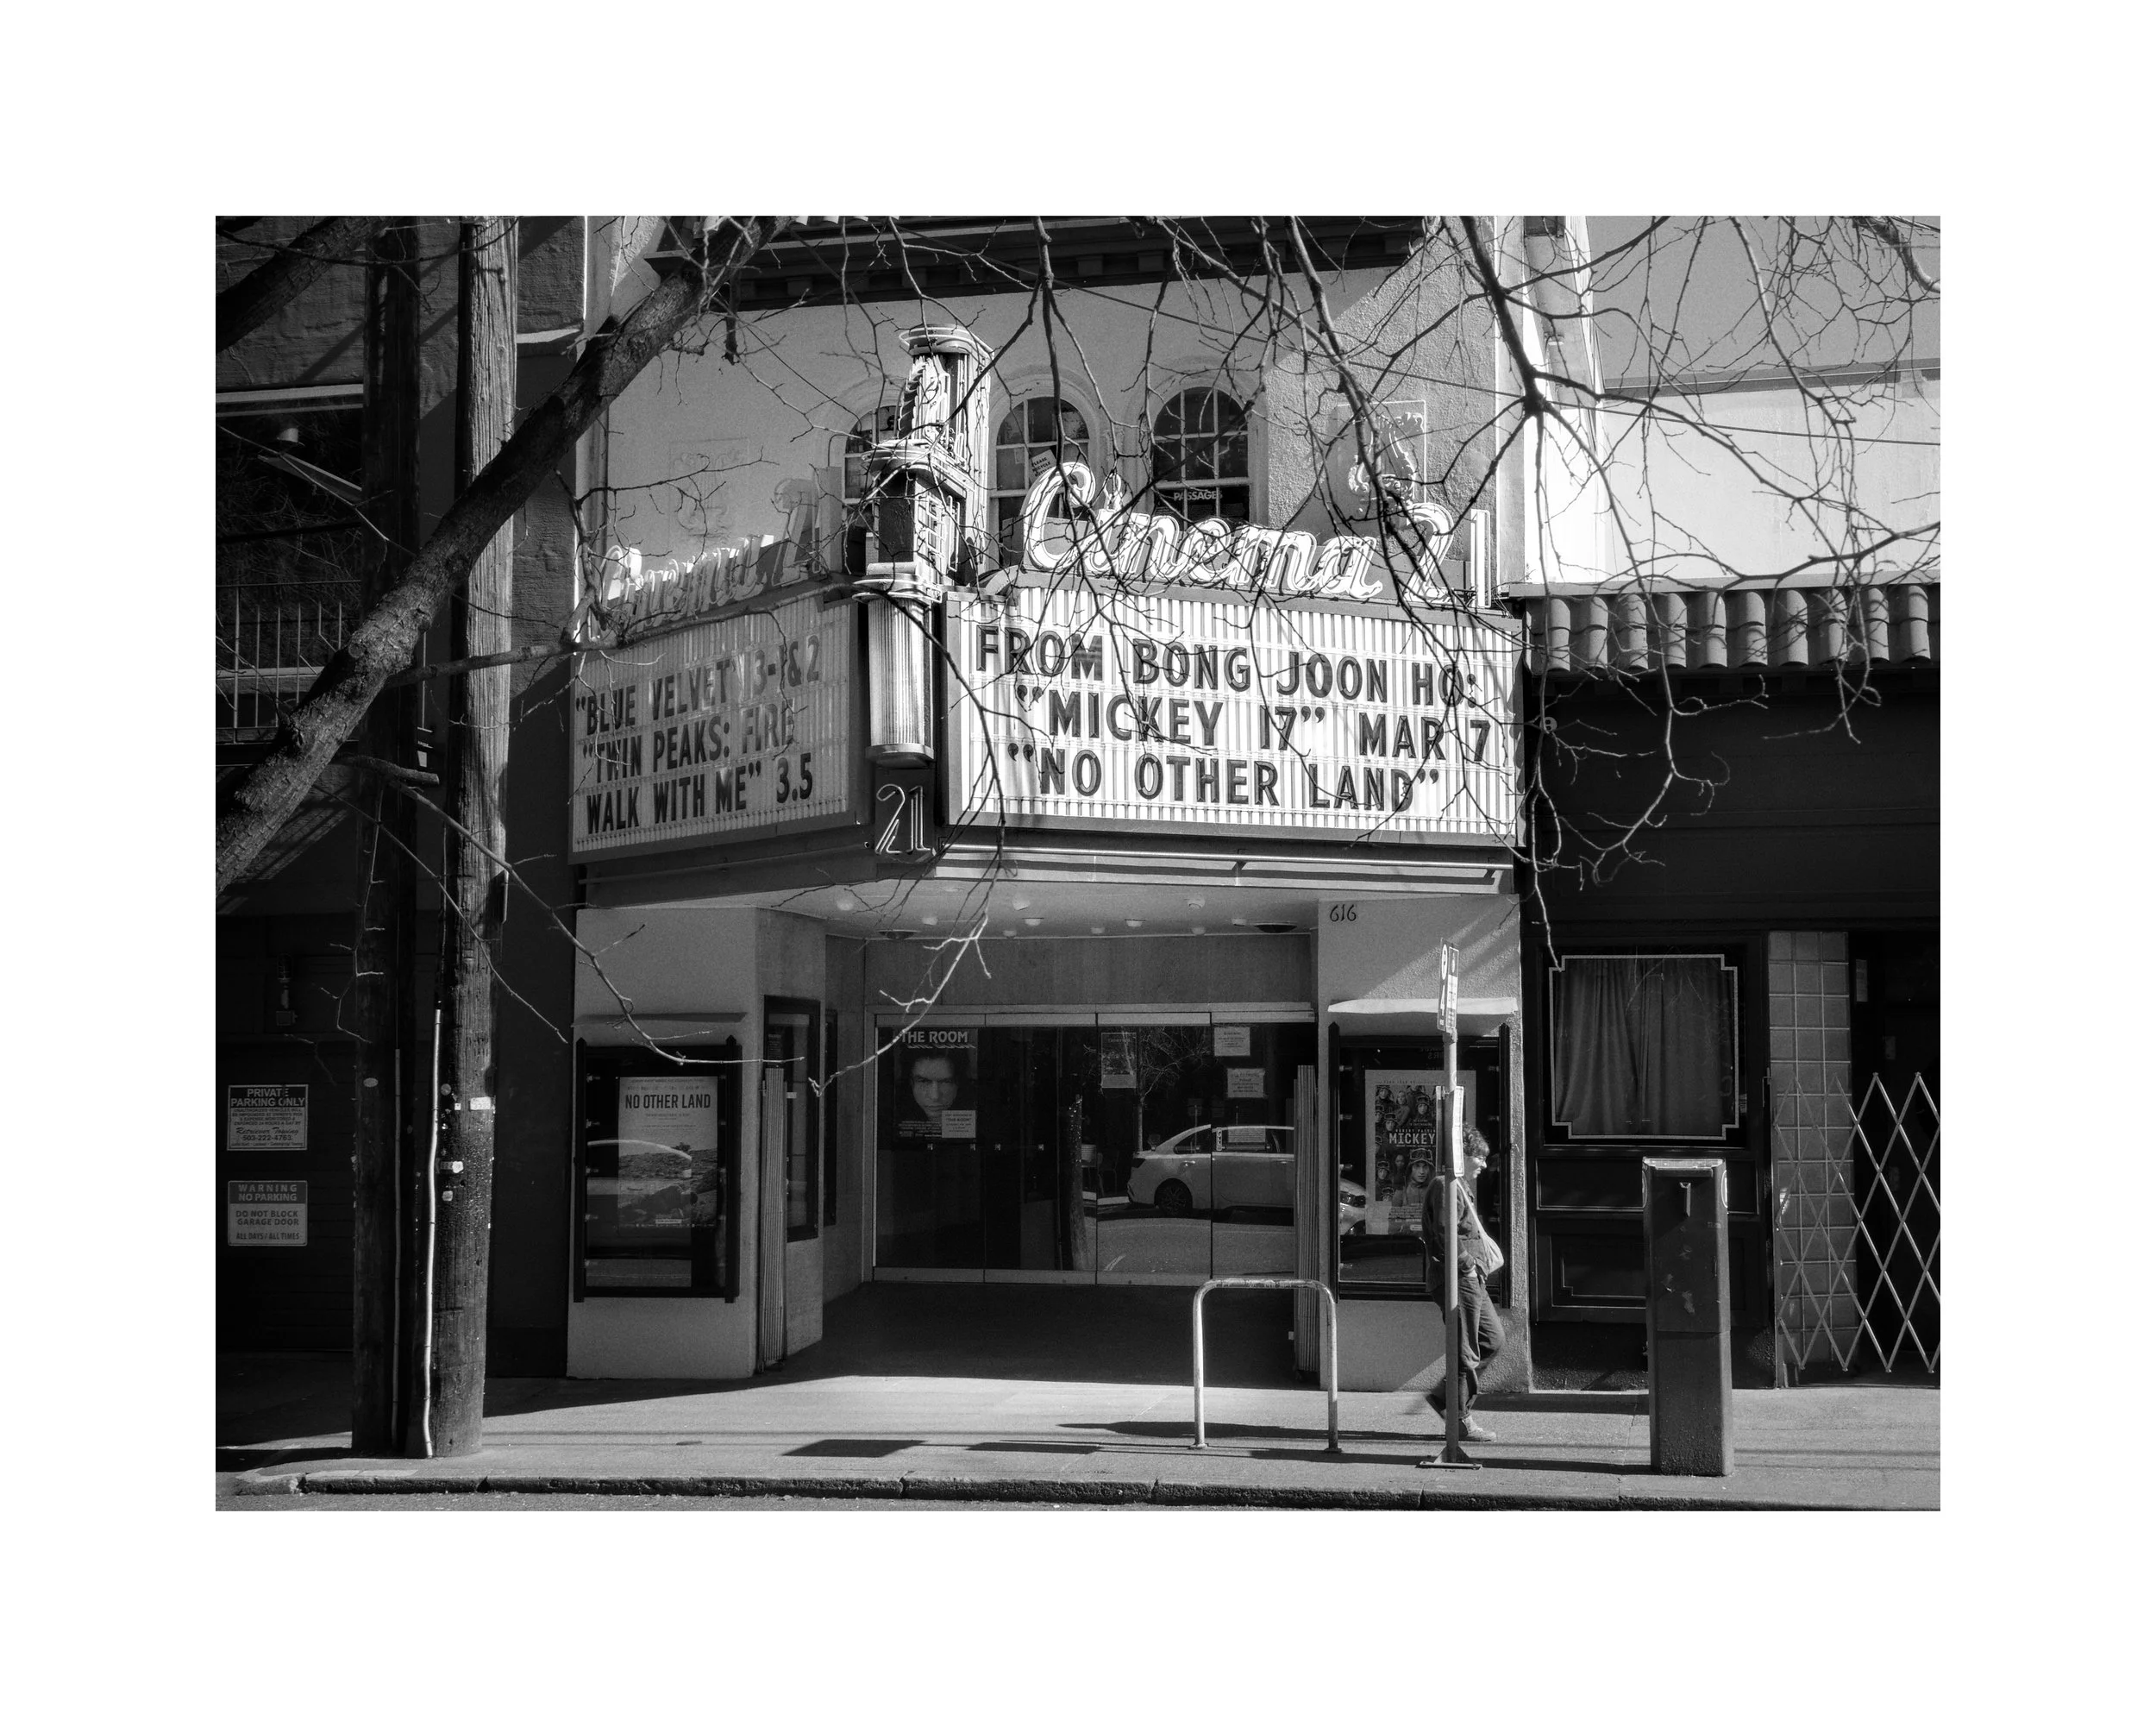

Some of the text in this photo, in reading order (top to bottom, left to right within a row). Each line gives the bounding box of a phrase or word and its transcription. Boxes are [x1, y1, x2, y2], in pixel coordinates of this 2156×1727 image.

[1019, 462, 1491, 608] Cinema 21
[976, 625, 1476, 707] FROM BONG JOON HO:
[576, 685, 636, 736] "BLUE
[1017, 685, 1491, 762] "MICKEY 17" MAR 7
[583, 699, 794, 783] "TWIN PEAKS: FIRE
[586, 752, 813, 835] WALK WITH ME" 3.5
[1008, 743, 1438, 813] "NO OTHER LAND"
[874, 783, 931, 855] 21
[1330, 904, 1357, 922] 616
[901, 1031, 968, 1044] THE ROOM
[231, 1097, 305, 1107] PARKING ONLY
[247, 1088, 290, 1097] PRIVATE
[625, 1094, 711, 1108] NO OTHER LAND
[1388, 1133, 1435, 1145] MICKEY
[238, 1184, 298, 1192] WARNING
[238, 1193, 298, 1202] NO PARKING
